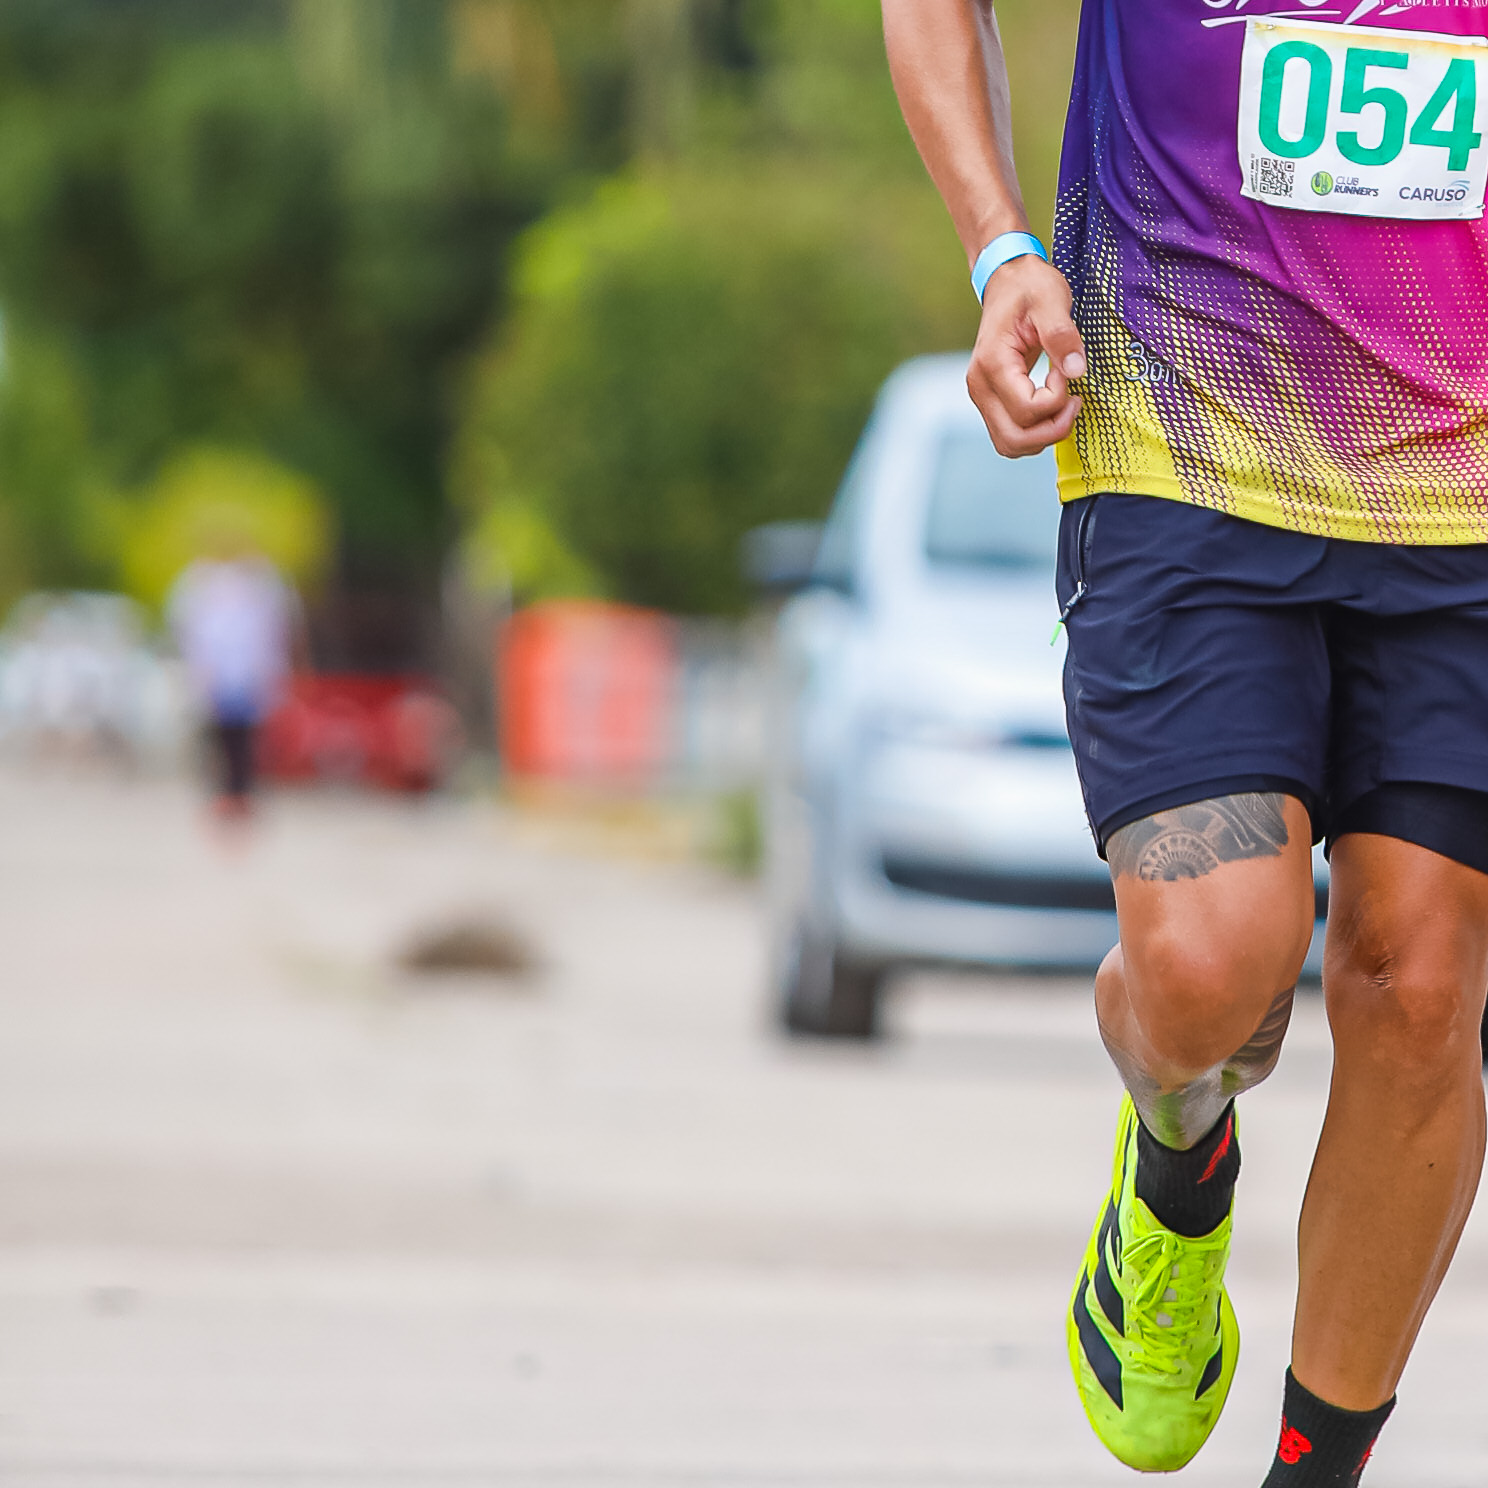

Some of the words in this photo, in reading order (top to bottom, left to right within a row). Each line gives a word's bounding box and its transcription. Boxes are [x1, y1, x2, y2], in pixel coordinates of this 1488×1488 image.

[1258, 40, 1482, 172] 054
[1335, 176, 1360, 185] CLUB
[1399, 186, 1466, 202] CARUSO
